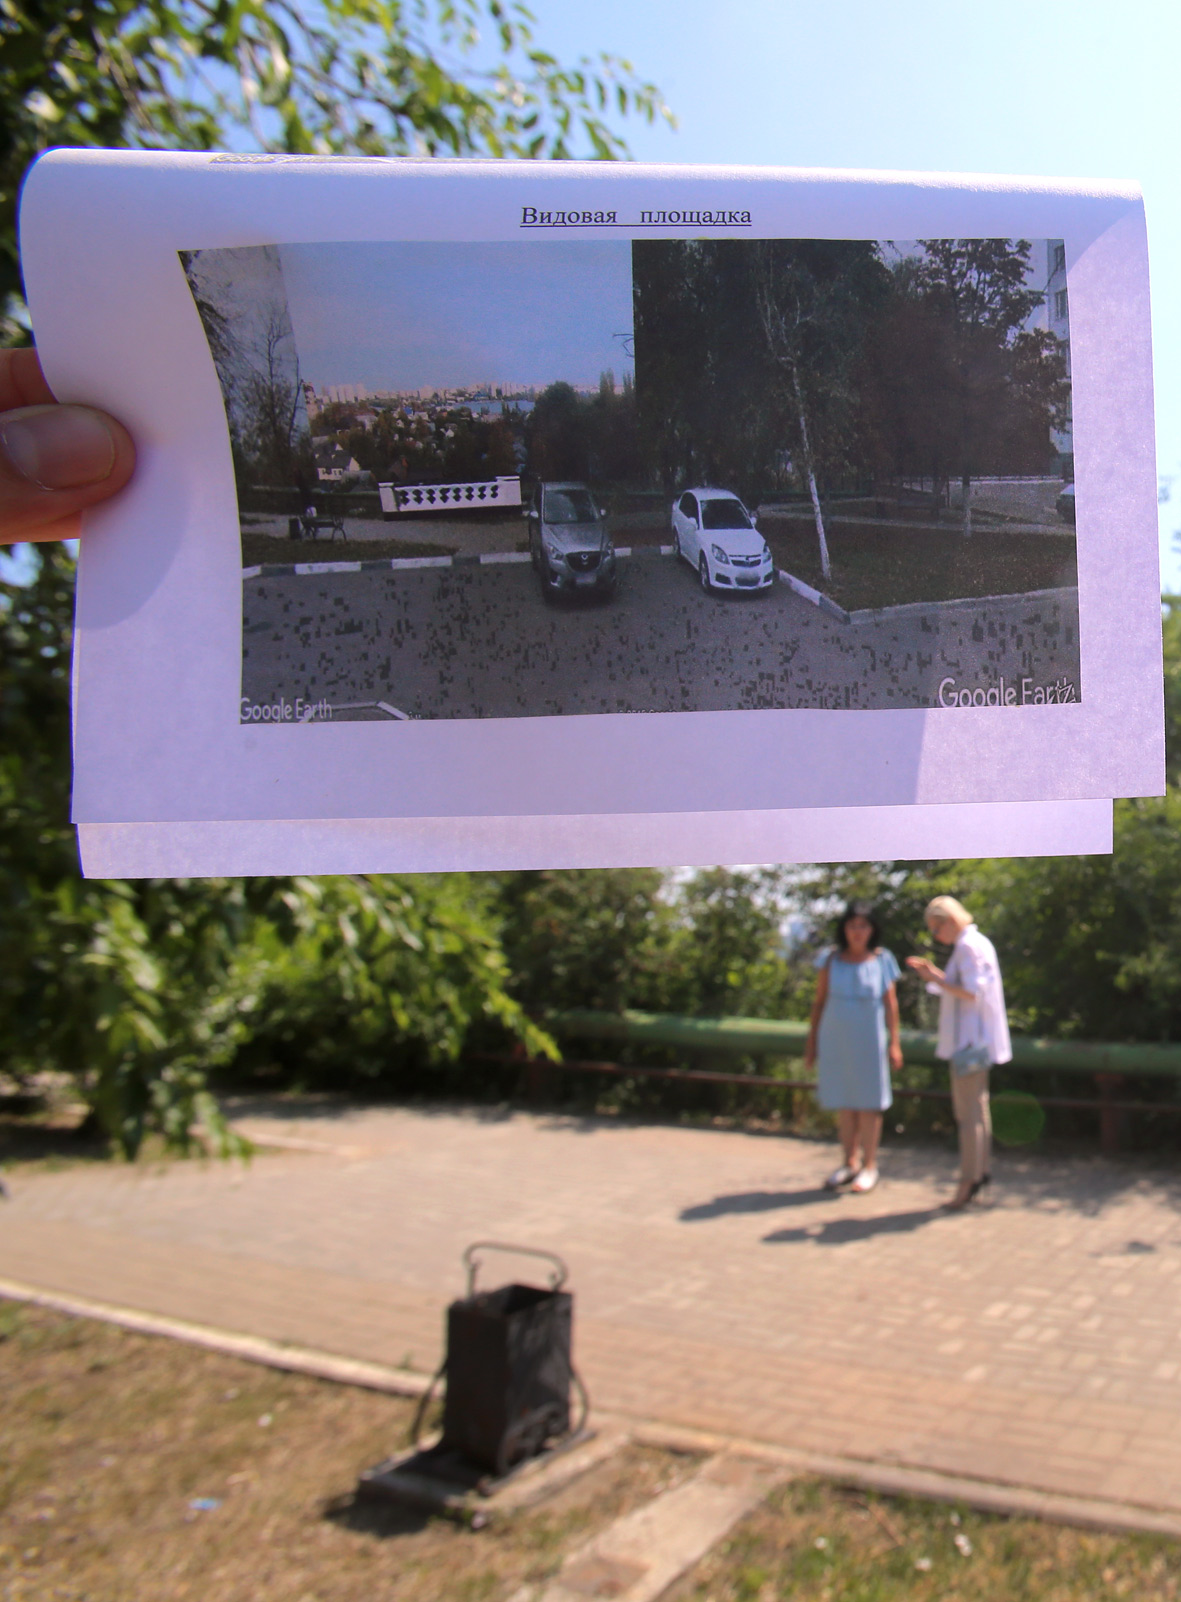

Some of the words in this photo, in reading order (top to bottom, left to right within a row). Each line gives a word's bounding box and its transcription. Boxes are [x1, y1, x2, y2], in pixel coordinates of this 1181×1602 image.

[521, 207, 617, 226] Видовая
[640, 210, 752, 226] площадка
[939, 677, 1016, 707] Google
[240, 697, 292, 722] Google
[295, 698, 333, 719] Earth
